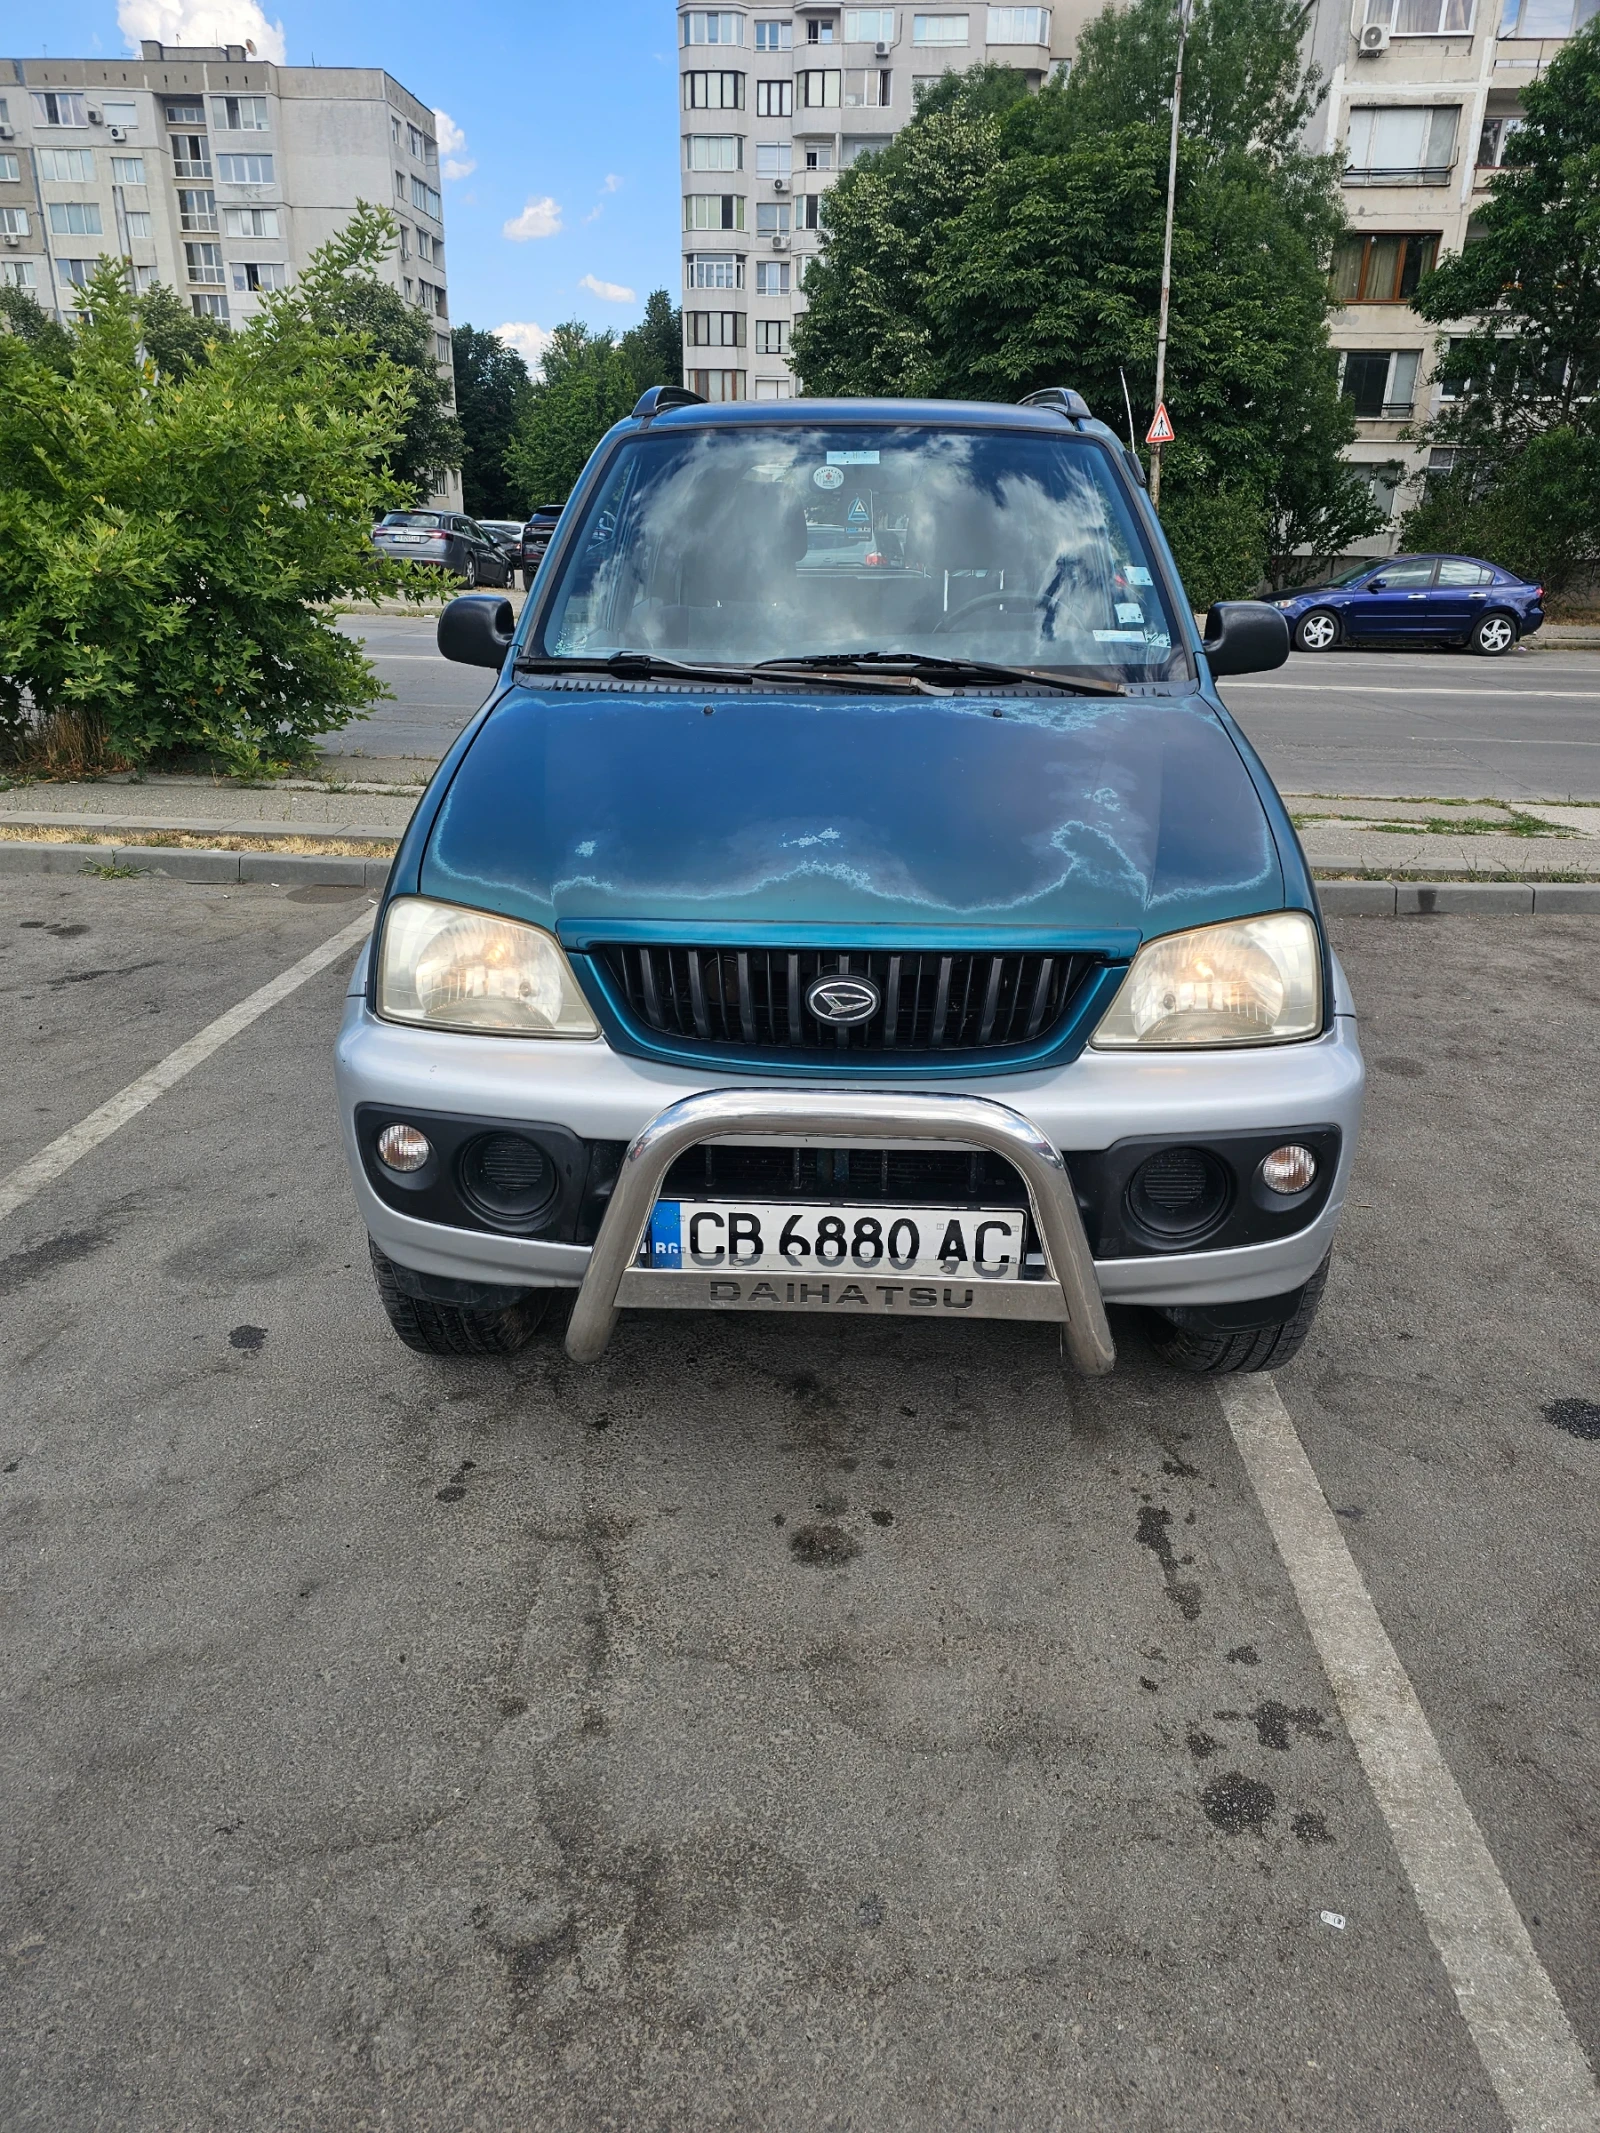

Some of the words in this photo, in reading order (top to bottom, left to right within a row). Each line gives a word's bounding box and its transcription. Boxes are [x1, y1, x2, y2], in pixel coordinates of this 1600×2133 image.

[689, 1211, 764, 1257] CB
[778, 1214, 920, 1260] 6880
[936, 1218, 1012, 1264] AC
[709, 1281, 974, 1310] DAIHATSU
